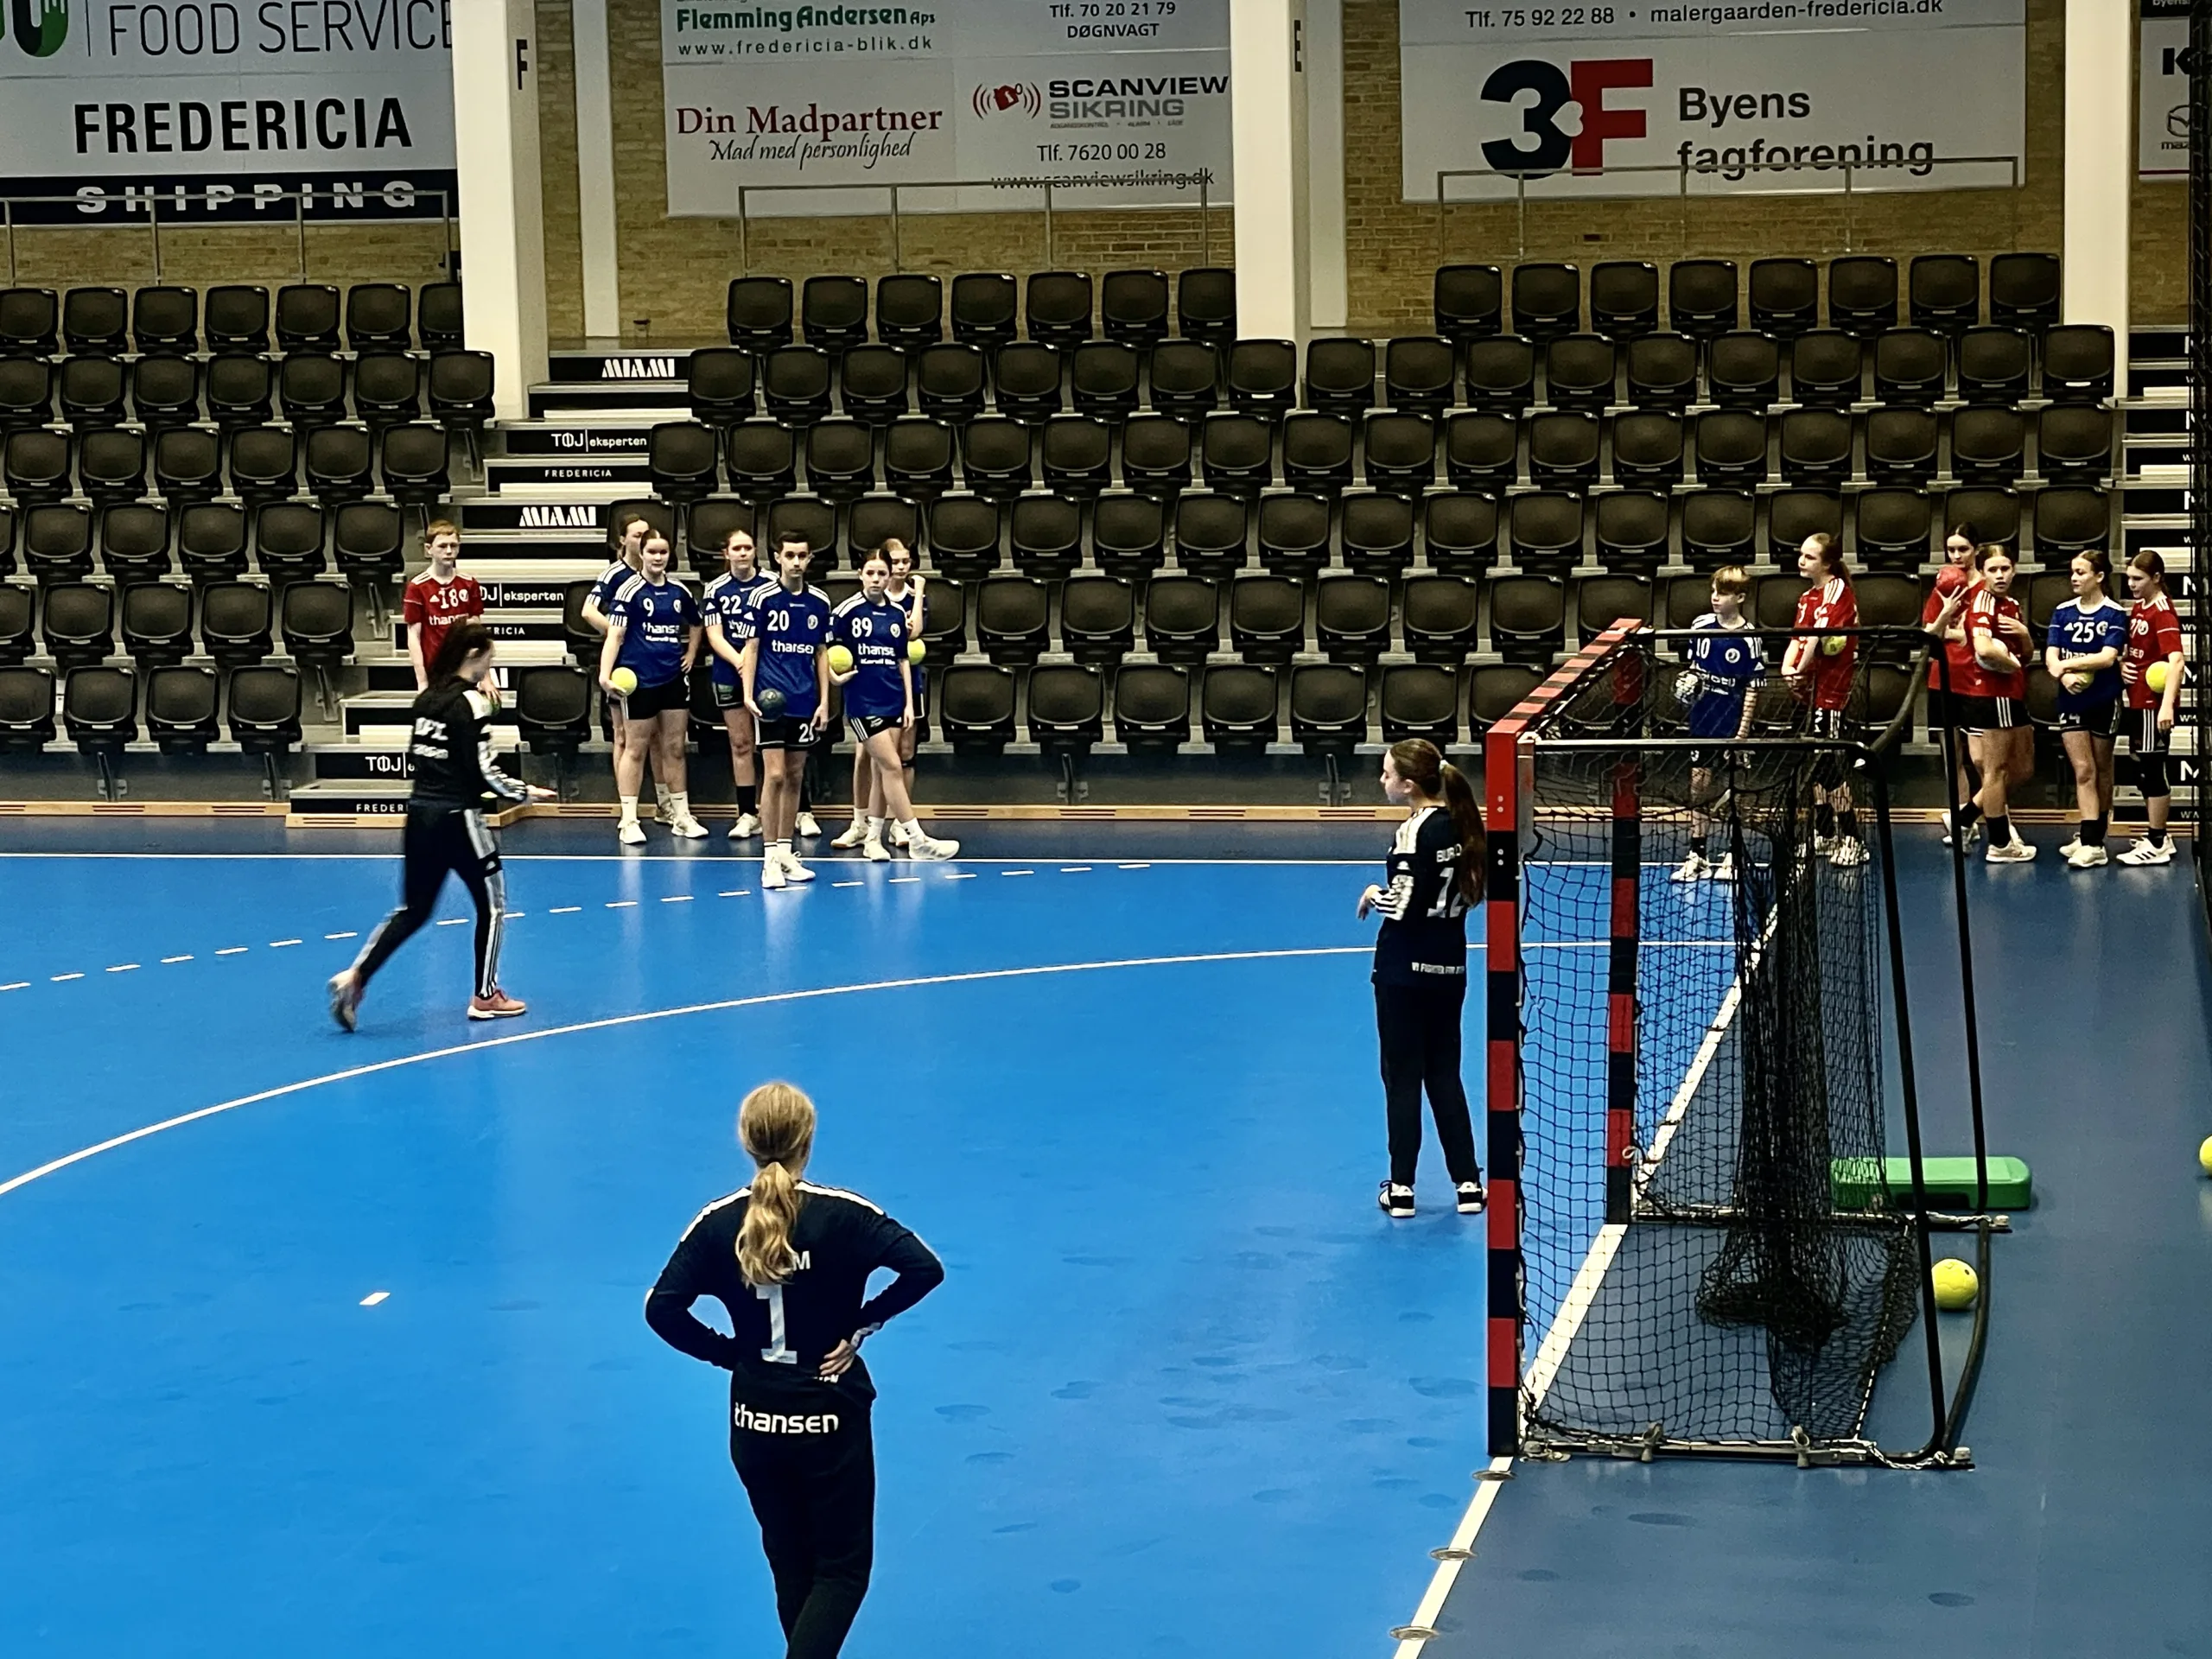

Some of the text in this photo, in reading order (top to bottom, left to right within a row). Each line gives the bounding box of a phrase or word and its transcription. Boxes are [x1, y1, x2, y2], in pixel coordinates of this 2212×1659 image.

[677, 5, 936, 32] Flemming Andersen Aps
[1049, 2, 1176, 17] Tlf. 70 20 21 79
[1465, 0, 1943, 28] Tlf. 75 92 22 88 malergaarden-fredericia.dk
[110, 3, 239, 56] FOOD
[1067, 22, 1160, 39] DØGNVAGT
[678, 35, 932, 55] www.fredericia-blik.dk
[516, 39, 527, 90] F
[1049, 76, 1229, 99] SCANVIEW
[1049, 99, 1185, 119] SIKRING
[1480, 58, 1653, 180] 3F
[1680, 87, 1811, 129] Byens
[74, 97, 413, 154] FREDERICIA
[676, 103, 944, 142] Din Madpartner
[709, 131, 917, 170] Mad med personlighed
[1037, 143, 1166, 162] Tlf. 7620 00 28
[2161, 142, 2190, 150] maz
[1677, 135, 1934, 181] fagforening
[76, 181, 415, 213] SHIPPING
[601, 359, 676, 378] MIAMI
[589, 435, 647, 448] eksperten
[544, 469, 612, 478] FREDERICIA
[518, 506, 597, 526] MIAMI
[504, 590, 564, 603] eksperten
[642, 597, 655, 617] 9
[719, 594, 743, 614] 22
[486, 626, 525, 635] RICIA
[766, 609, 790, 631] 20
[851, 617, 873, 639] 89
[2071, 621, 2094, 643] 25
[756, 1282, 798, 1364] 1
[734, 1402, 839, 1433] thansen
